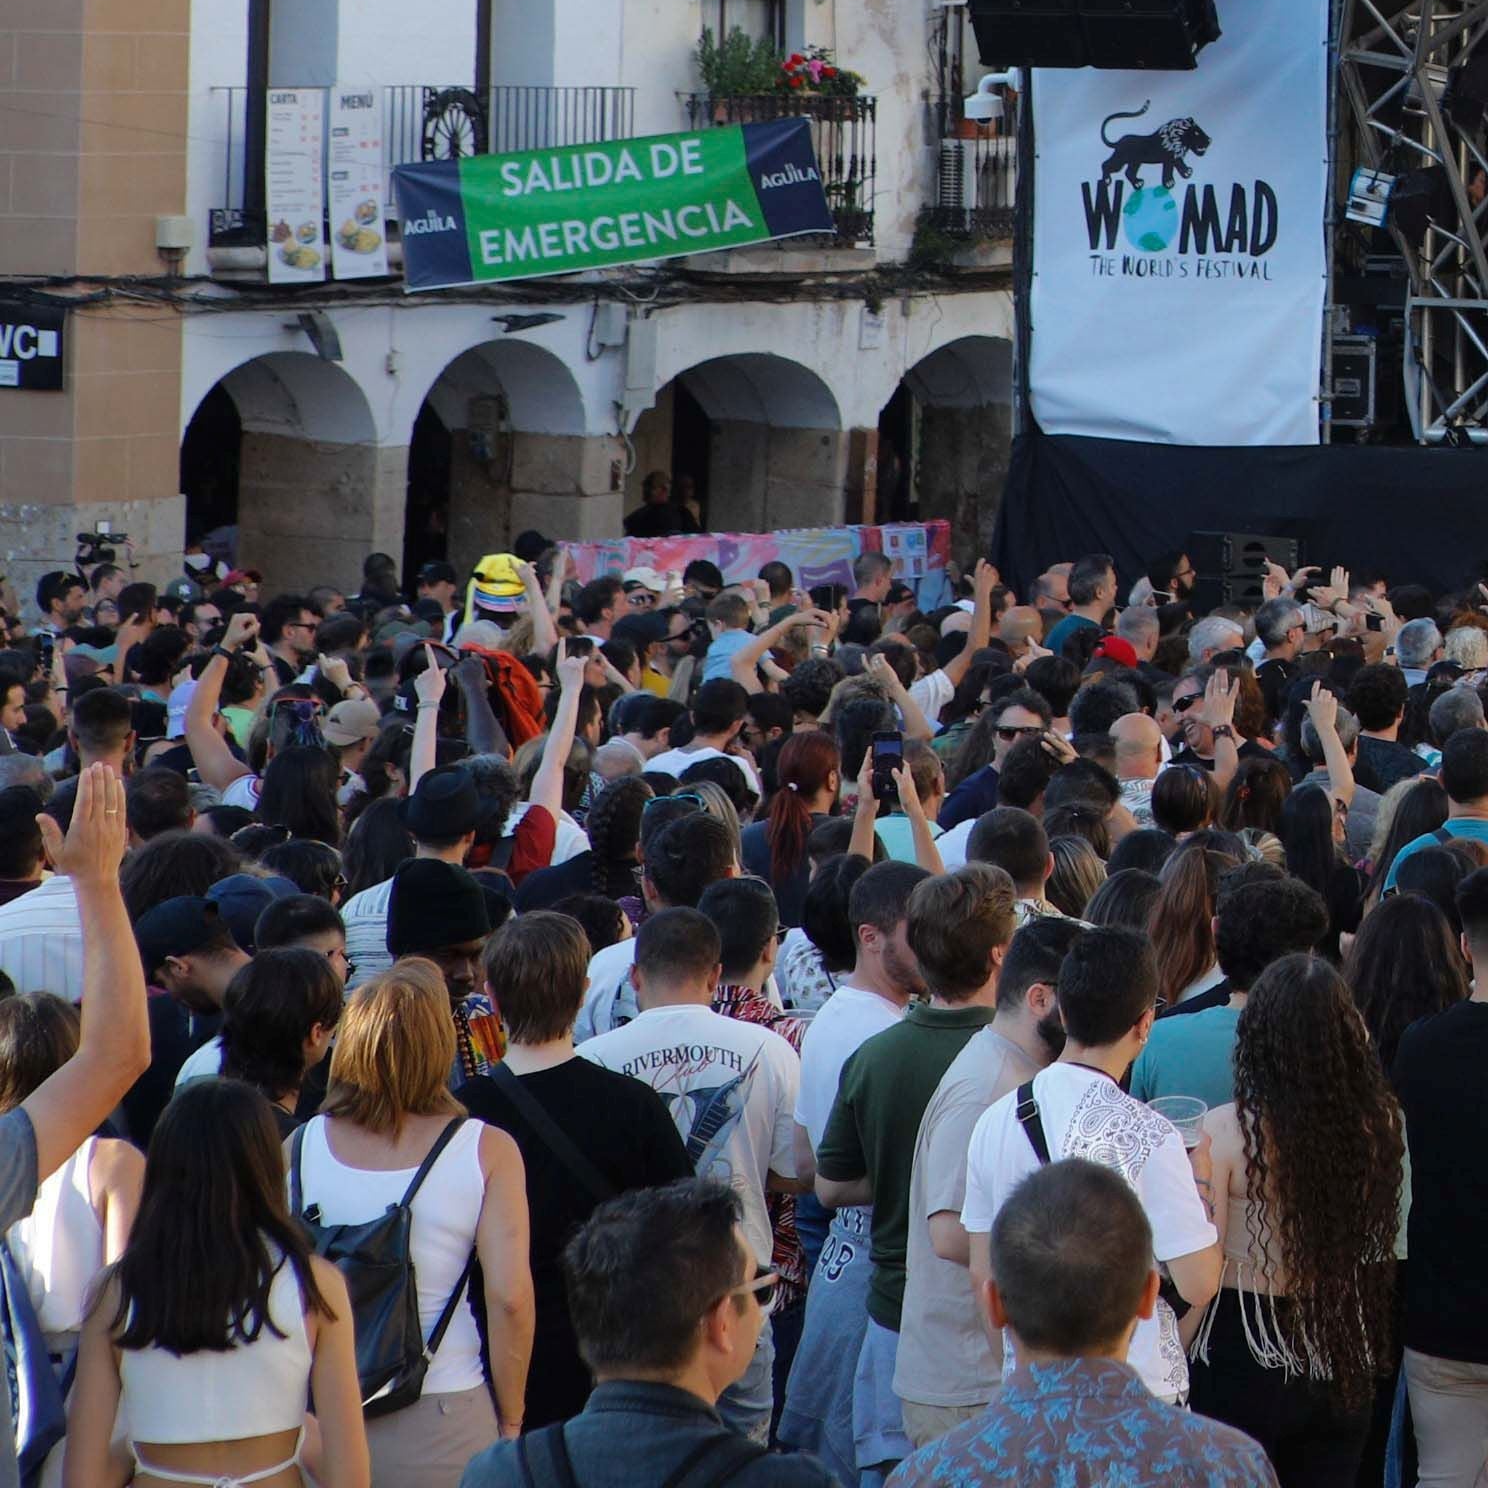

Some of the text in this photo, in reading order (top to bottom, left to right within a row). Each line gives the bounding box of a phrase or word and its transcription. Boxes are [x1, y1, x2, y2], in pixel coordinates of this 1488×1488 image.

[501, 139, 704, 197] SALIDA DE
[480, 200, 754, 265] EMERGENCIA
[1089, 254, 1117, 277] THE
[1196, 258, 1273, 281] FESTIVAL
[622, 1044, 743, 1077] RIVERMOUTH
